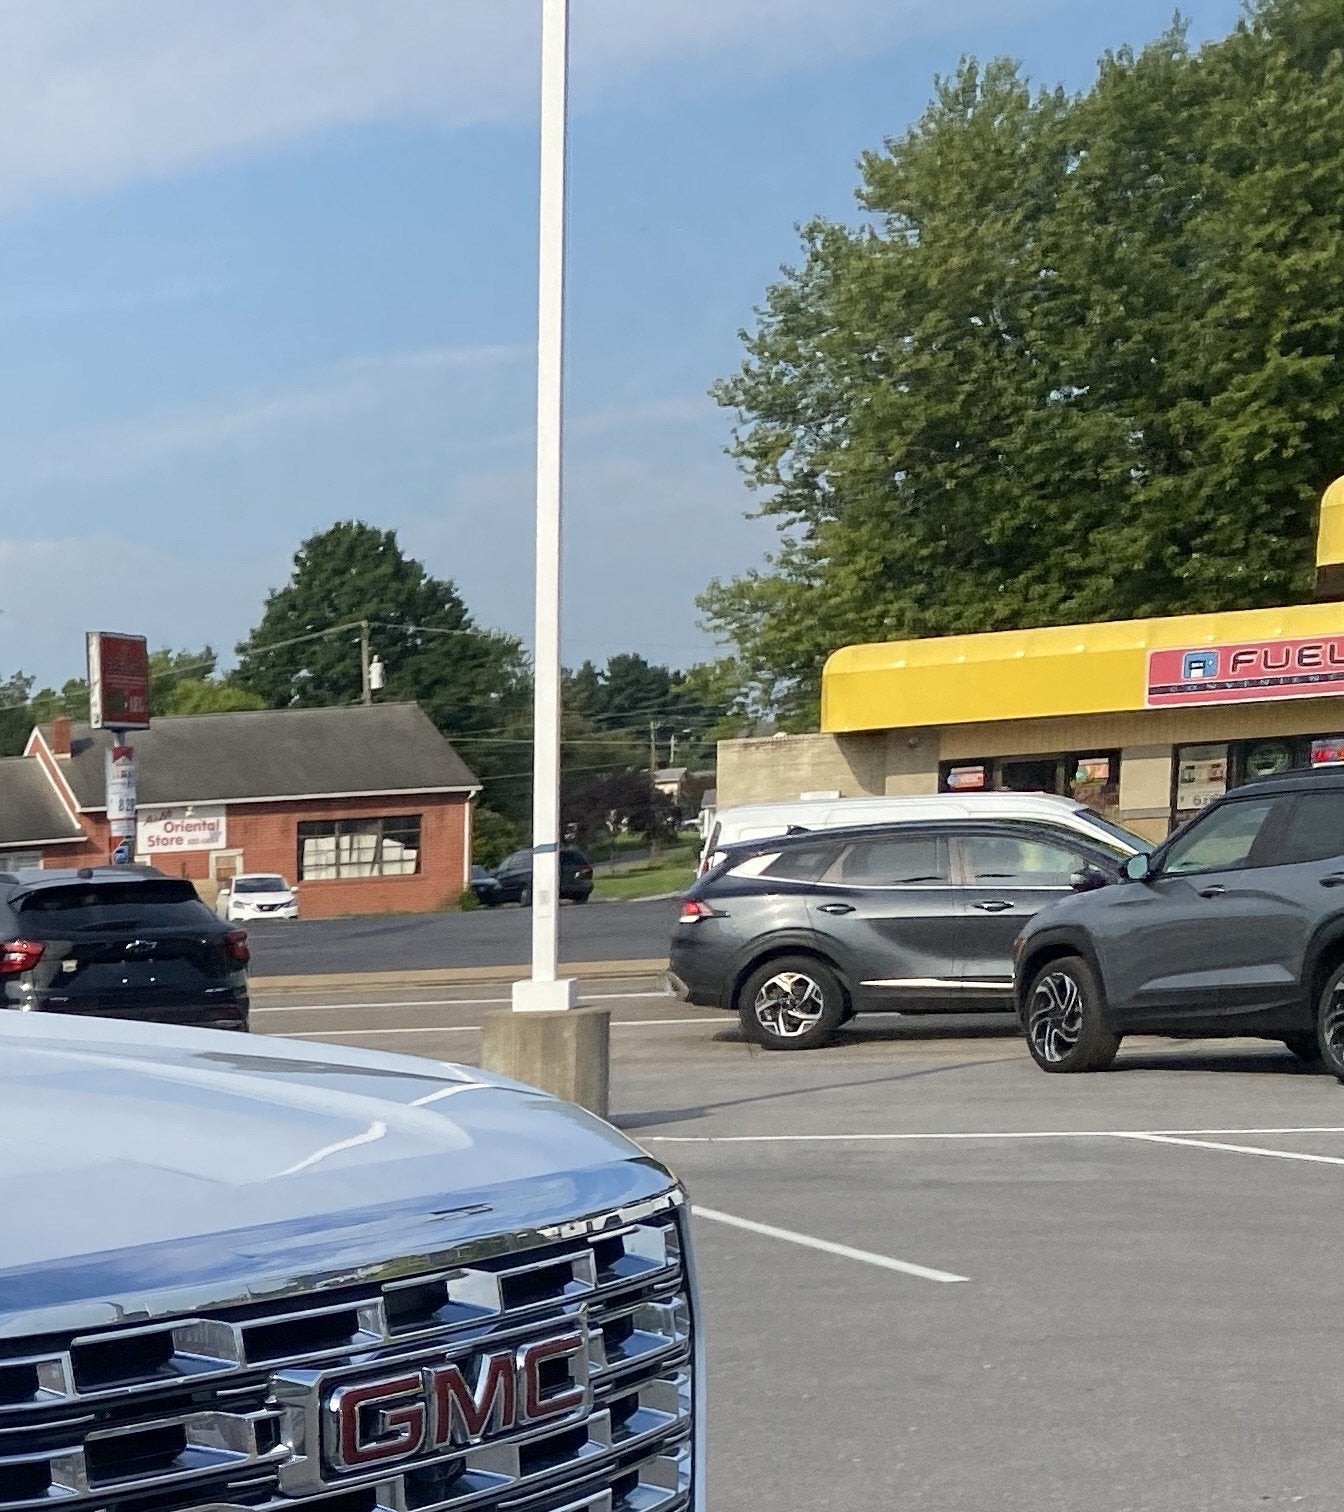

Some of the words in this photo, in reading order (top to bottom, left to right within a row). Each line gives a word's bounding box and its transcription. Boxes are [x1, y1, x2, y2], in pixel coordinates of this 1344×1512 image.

[1231, 644, 1344, 672] FUEL
[164, 819, 220, 834] Oriental
[148, 835, 184, 848] Store
[331, 1331, 588, 1472] GMC
